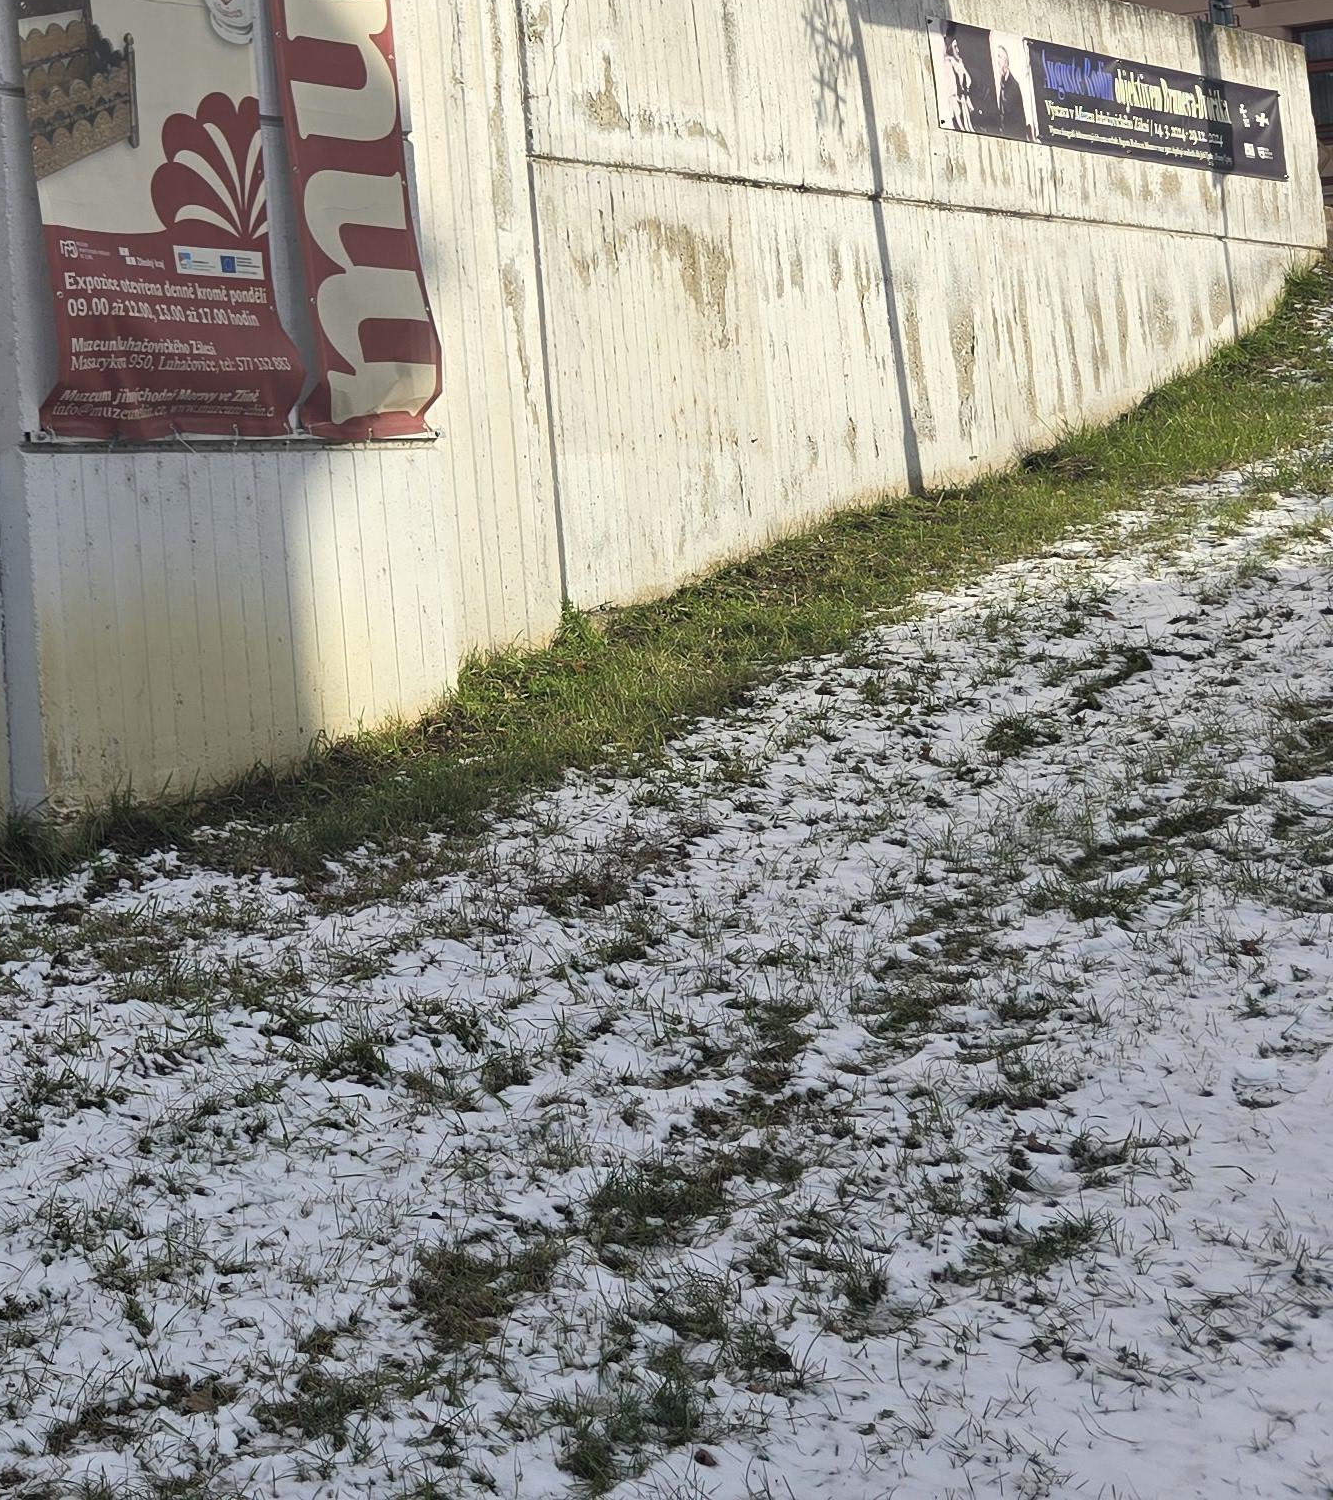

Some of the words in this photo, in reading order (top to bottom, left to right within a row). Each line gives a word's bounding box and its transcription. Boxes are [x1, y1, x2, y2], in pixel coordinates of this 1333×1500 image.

[1042, 49, 1085, 101] Auguste
[1083, 57, 1115, 102] Rodin
[64, 271, 120, 293] Expozice
[120, 277, 163, 297] otevřena
[164, 280, 195, 299] denně
[196, 283, 228, 302] kromě
[67, 298, 109, 317] 09.00
[111, 300, 124, 314] až
[155, 304, 185, 322] 13.00
[186, 307, 199, 323] až
[200, 307, 228, 325] 17.00
[229, 310, 260, 327] hodin
[128, 354, 154, 372] 950,
[157, 355, 219, 374] Luhačovice,
[59, 389, 111, 402] Muzeum
